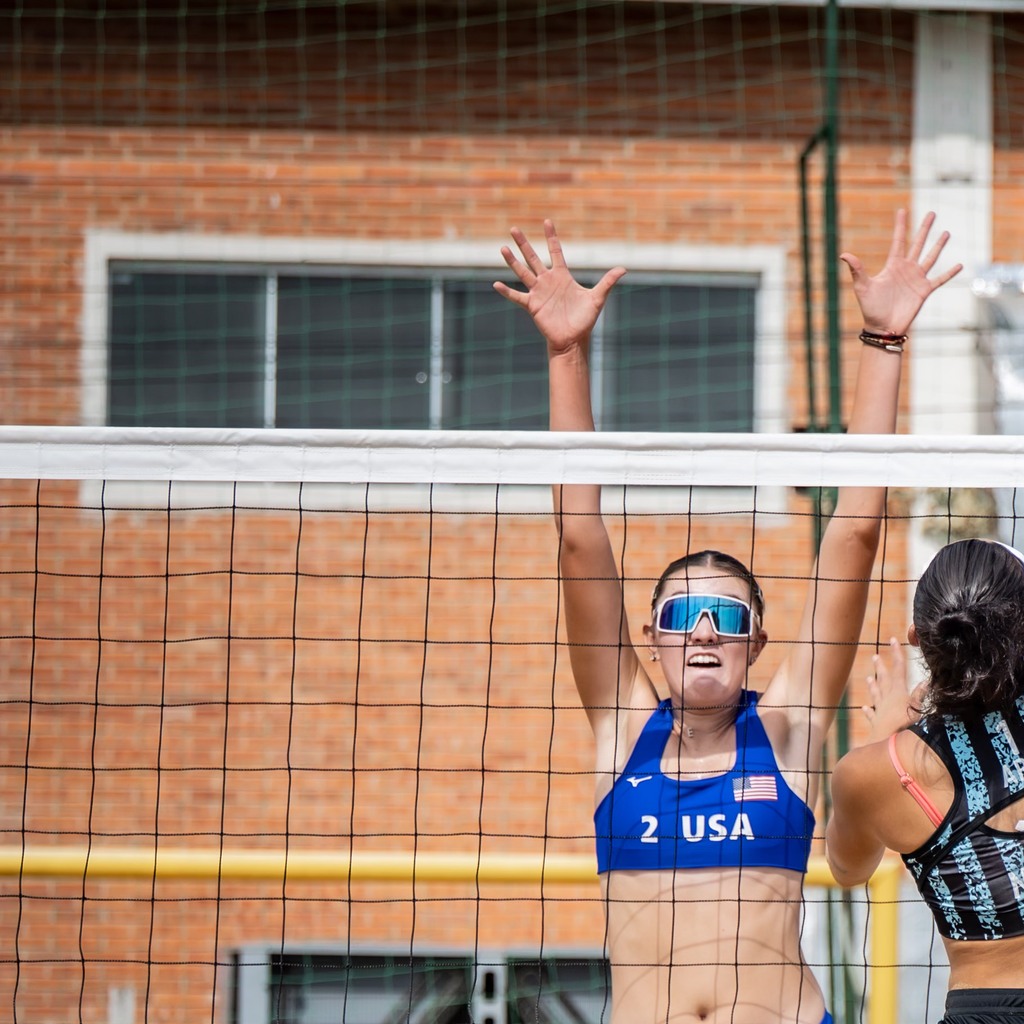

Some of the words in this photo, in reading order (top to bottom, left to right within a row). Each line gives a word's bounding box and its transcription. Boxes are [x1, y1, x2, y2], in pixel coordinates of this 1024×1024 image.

[995, 719, 1020, 755] 1
[640, 815, 659, 843] 2
[681, 813, 755, 843] USA
